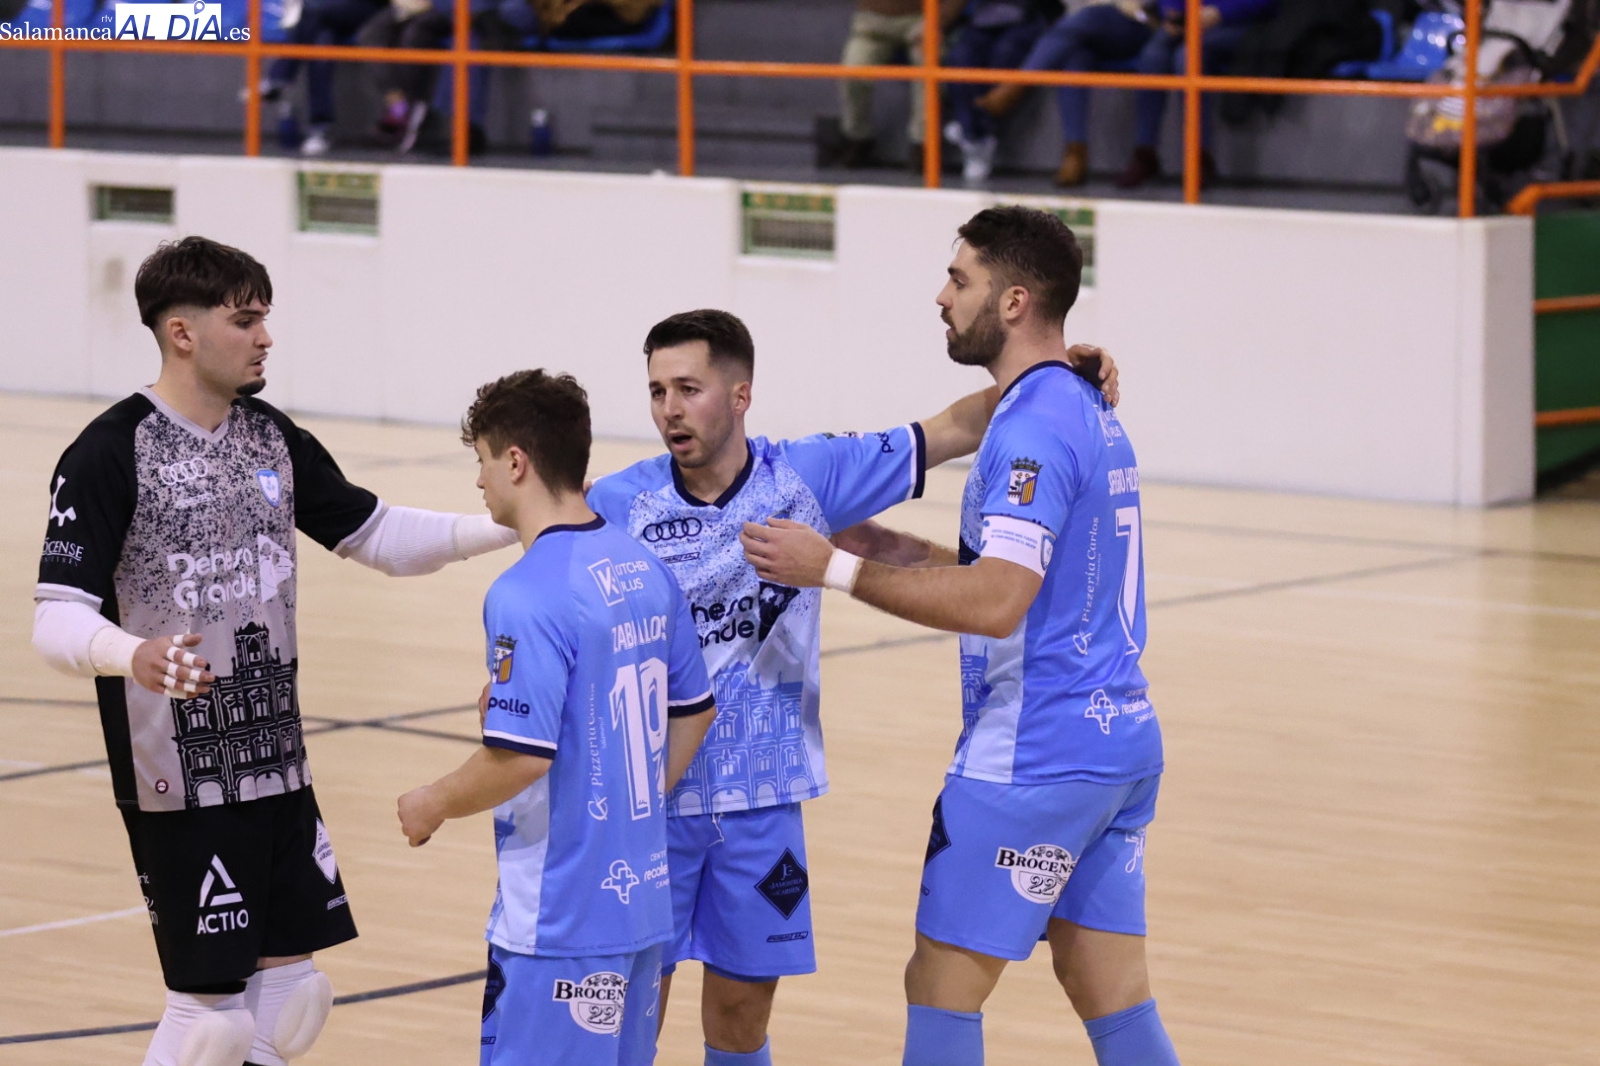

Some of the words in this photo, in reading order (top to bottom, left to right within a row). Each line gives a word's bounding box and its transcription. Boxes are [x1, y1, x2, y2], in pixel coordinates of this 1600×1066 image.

[1086, 517, 1099, 561] Carlos
[167, 547, 254, 580] Dehesa
[173, 571, 257, 610] Grande
[1115, 505, 1141, 657] 7
[1027, 875, 1057, 896] 22
[196, 908, 249, 935] ACTIO
[554, 980, 629, 1001] BROCEN
[587, 1004, 617, 1026] 22
